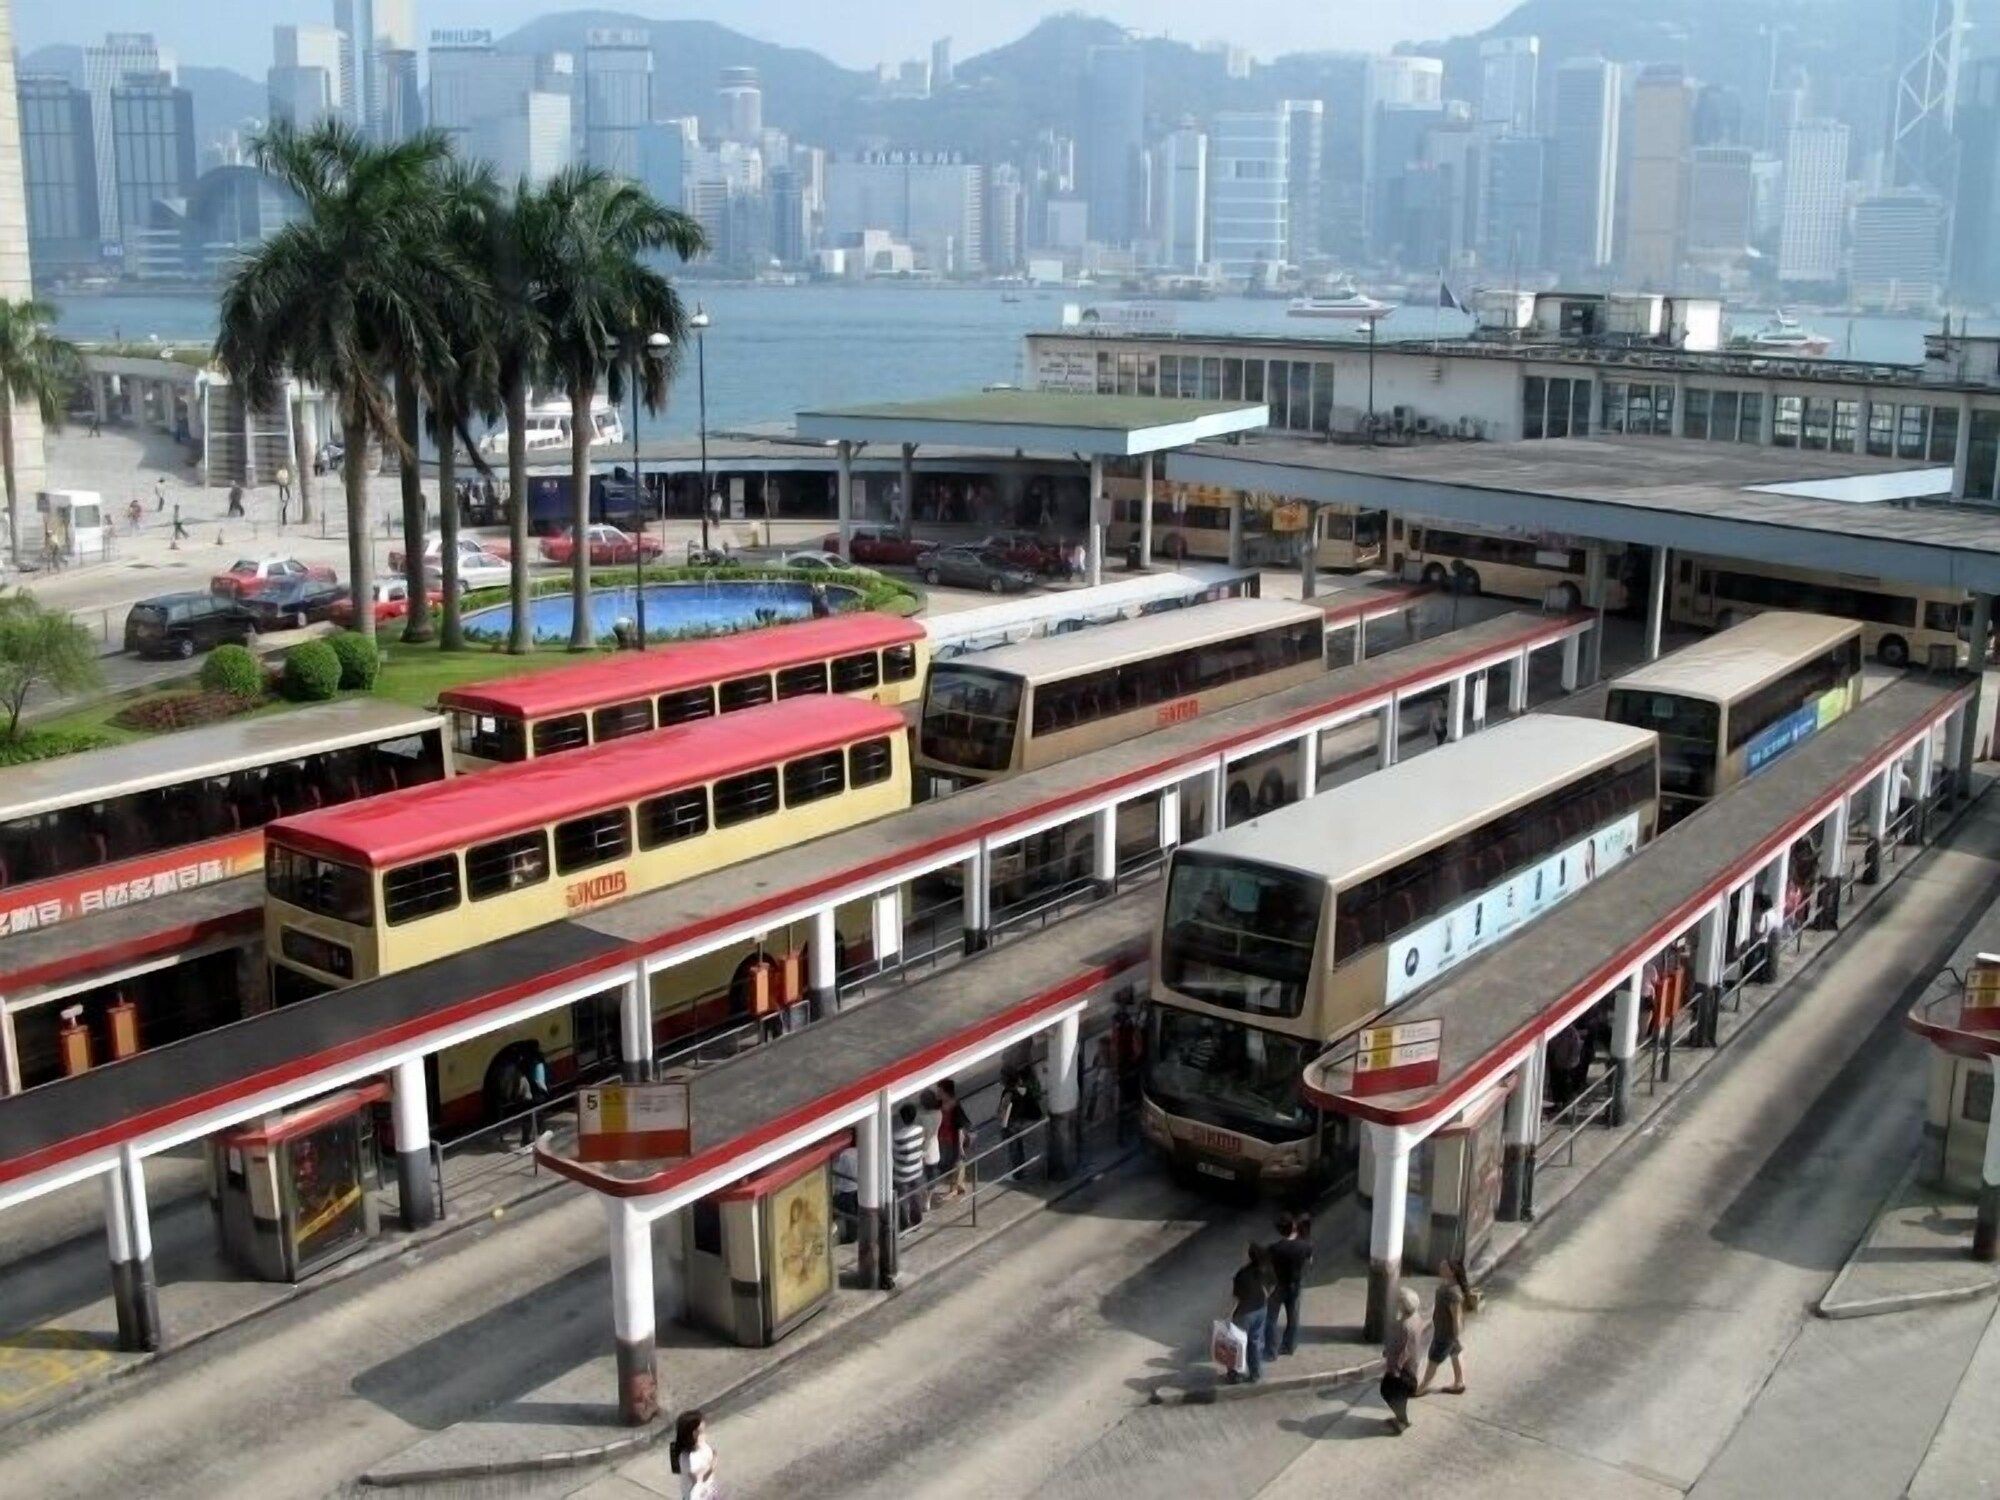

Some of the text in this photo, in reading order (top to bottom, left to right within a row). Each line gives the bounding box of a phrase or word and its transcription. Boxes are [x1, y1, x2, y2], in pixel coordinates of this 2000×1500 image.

[430, 29, 492, 43] PHILIPS
[863, 151, 961, 164] SAMSUNG
[586, 1094, 599, 1111] 5
